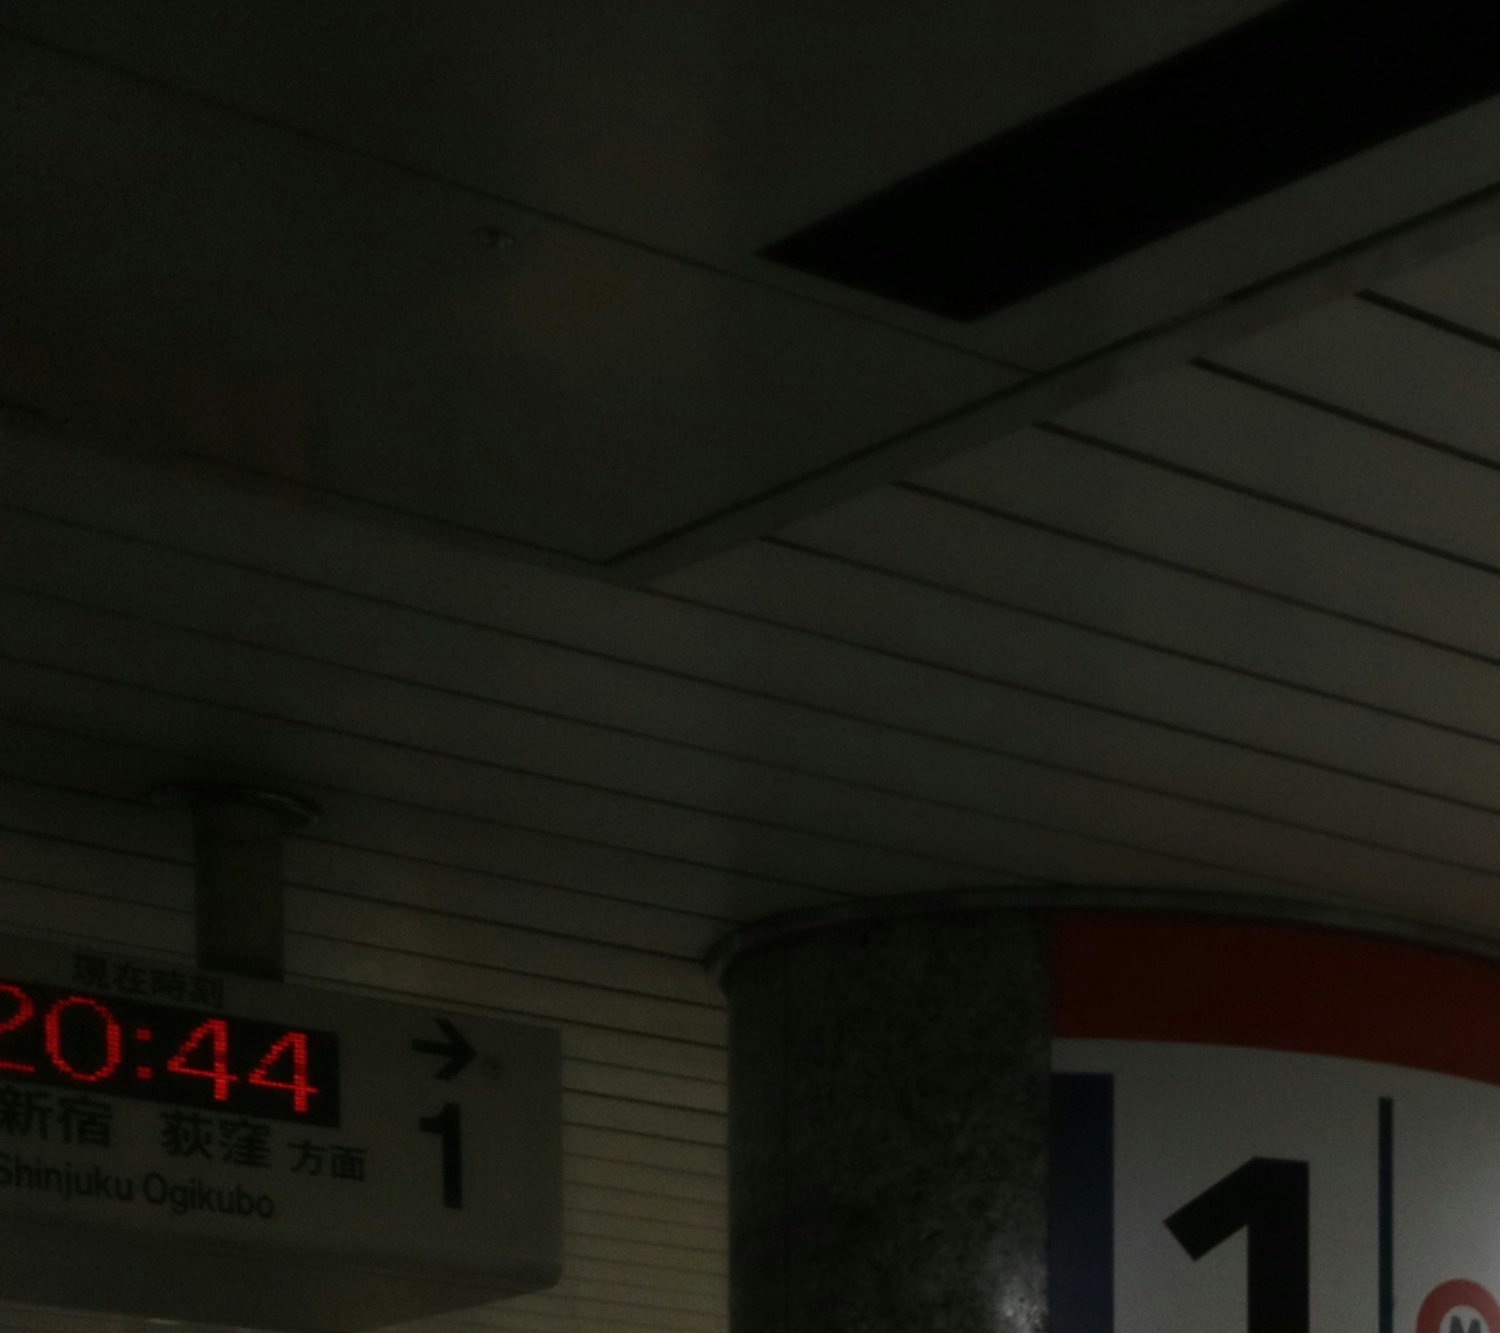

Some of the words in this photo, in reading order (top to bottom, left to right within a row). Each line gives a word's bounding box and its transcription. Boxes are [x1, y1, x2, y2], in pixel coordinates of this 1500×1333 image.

[71, 951, 225, 1009] 現在時刻
[419, 1102, 464, 1209] 1
[143, 1173, 275, 1219] Ogikubo
